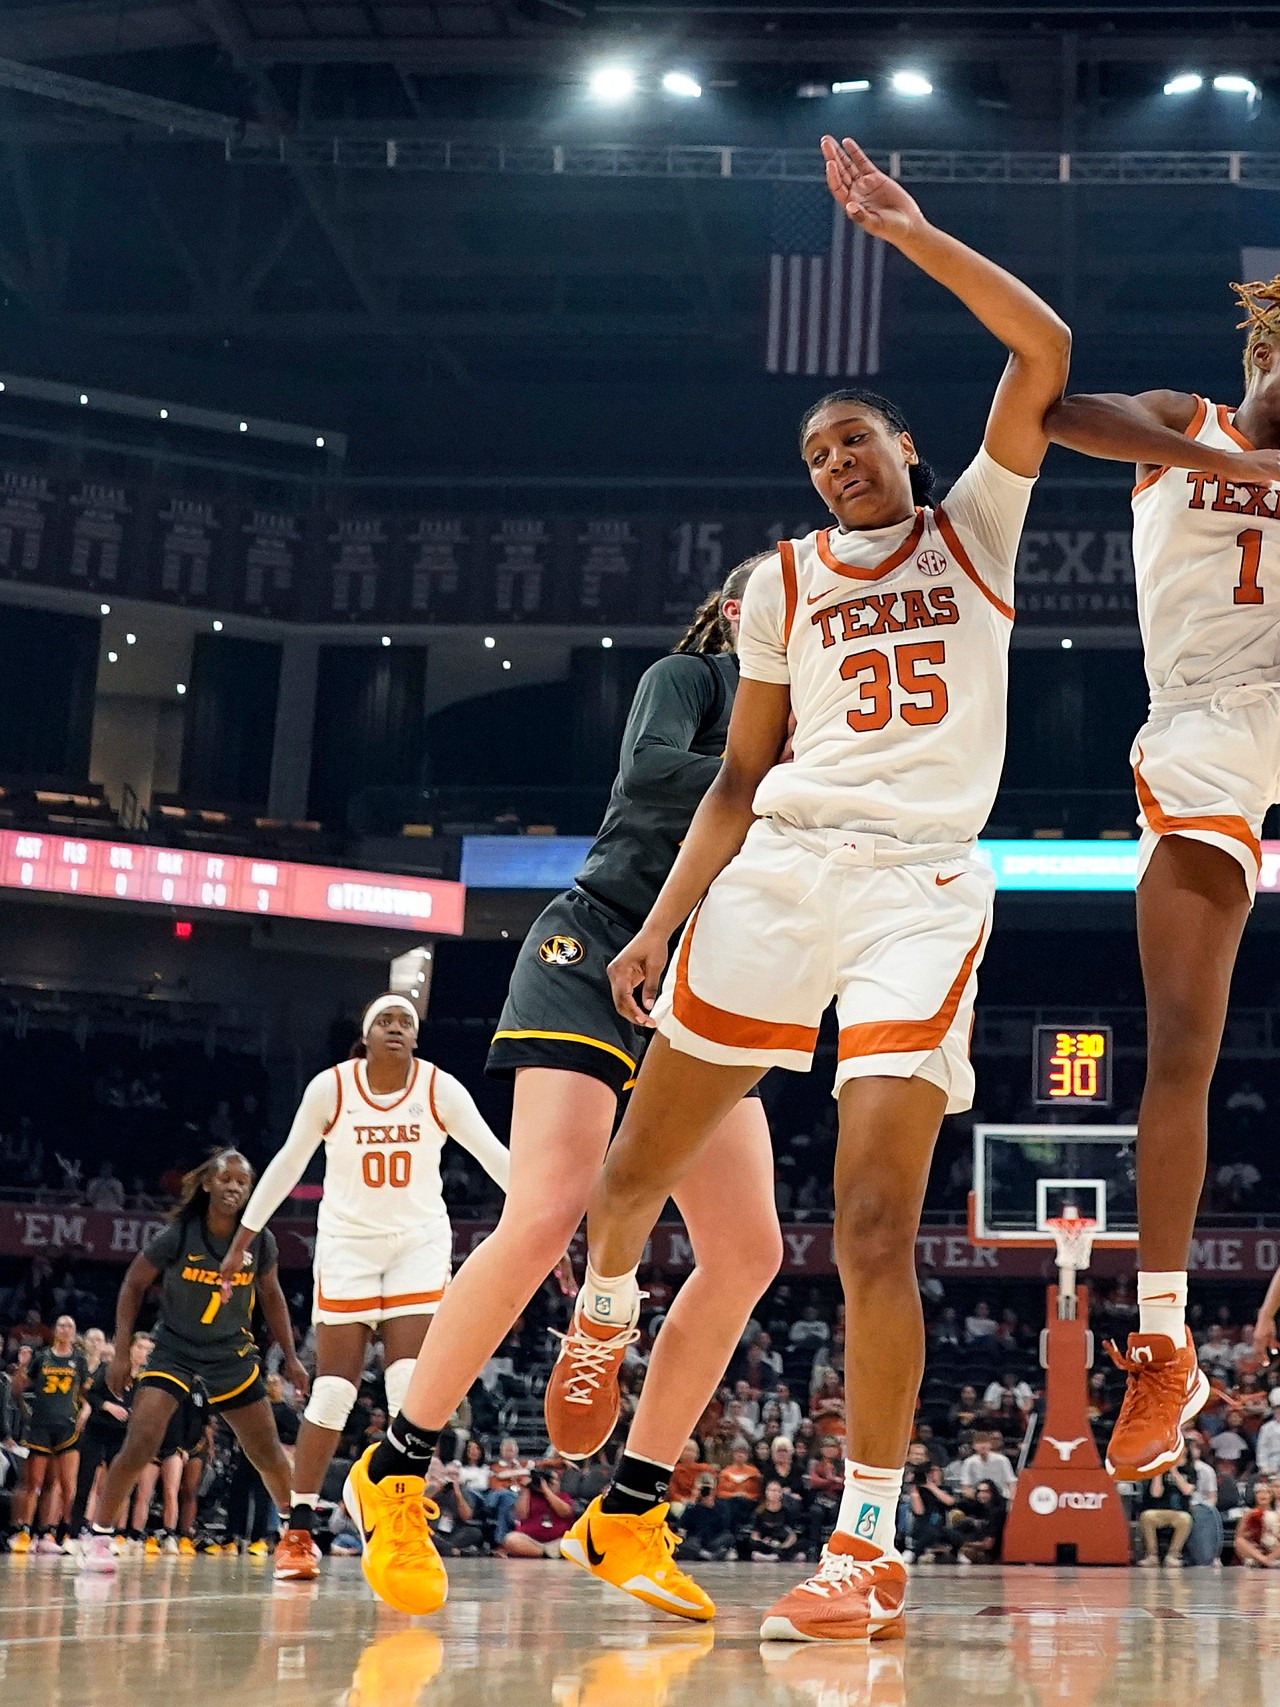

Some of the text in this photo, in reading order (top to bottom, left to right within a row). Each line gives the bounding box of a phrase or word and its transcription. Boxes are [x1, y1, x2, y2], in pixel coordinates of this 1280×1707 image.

[917, 550, 946, 576] SEC
[1015, 530, 1135, 583] EXA
[1233, 528, 1264, 604] 1
[811, 587, 960, 649] TEXAS
[1016, 593, 1134, 610] ASKETBAL
[839, 641, 948, 733] 35
[70, 868, 79, 890] 1
[1056, 1033, 1104, 1058] 3:30
[1049, 1058, 1097, 1096] 30
[353, 1125, 420, 1144] TEXAS
[362, 1151, 412, 1188] 00
[1188, 1238, 1243, 1271] ME
[200, 1291, 222, 1325] 1
[1058, 1492, 1109, 1510] razr
